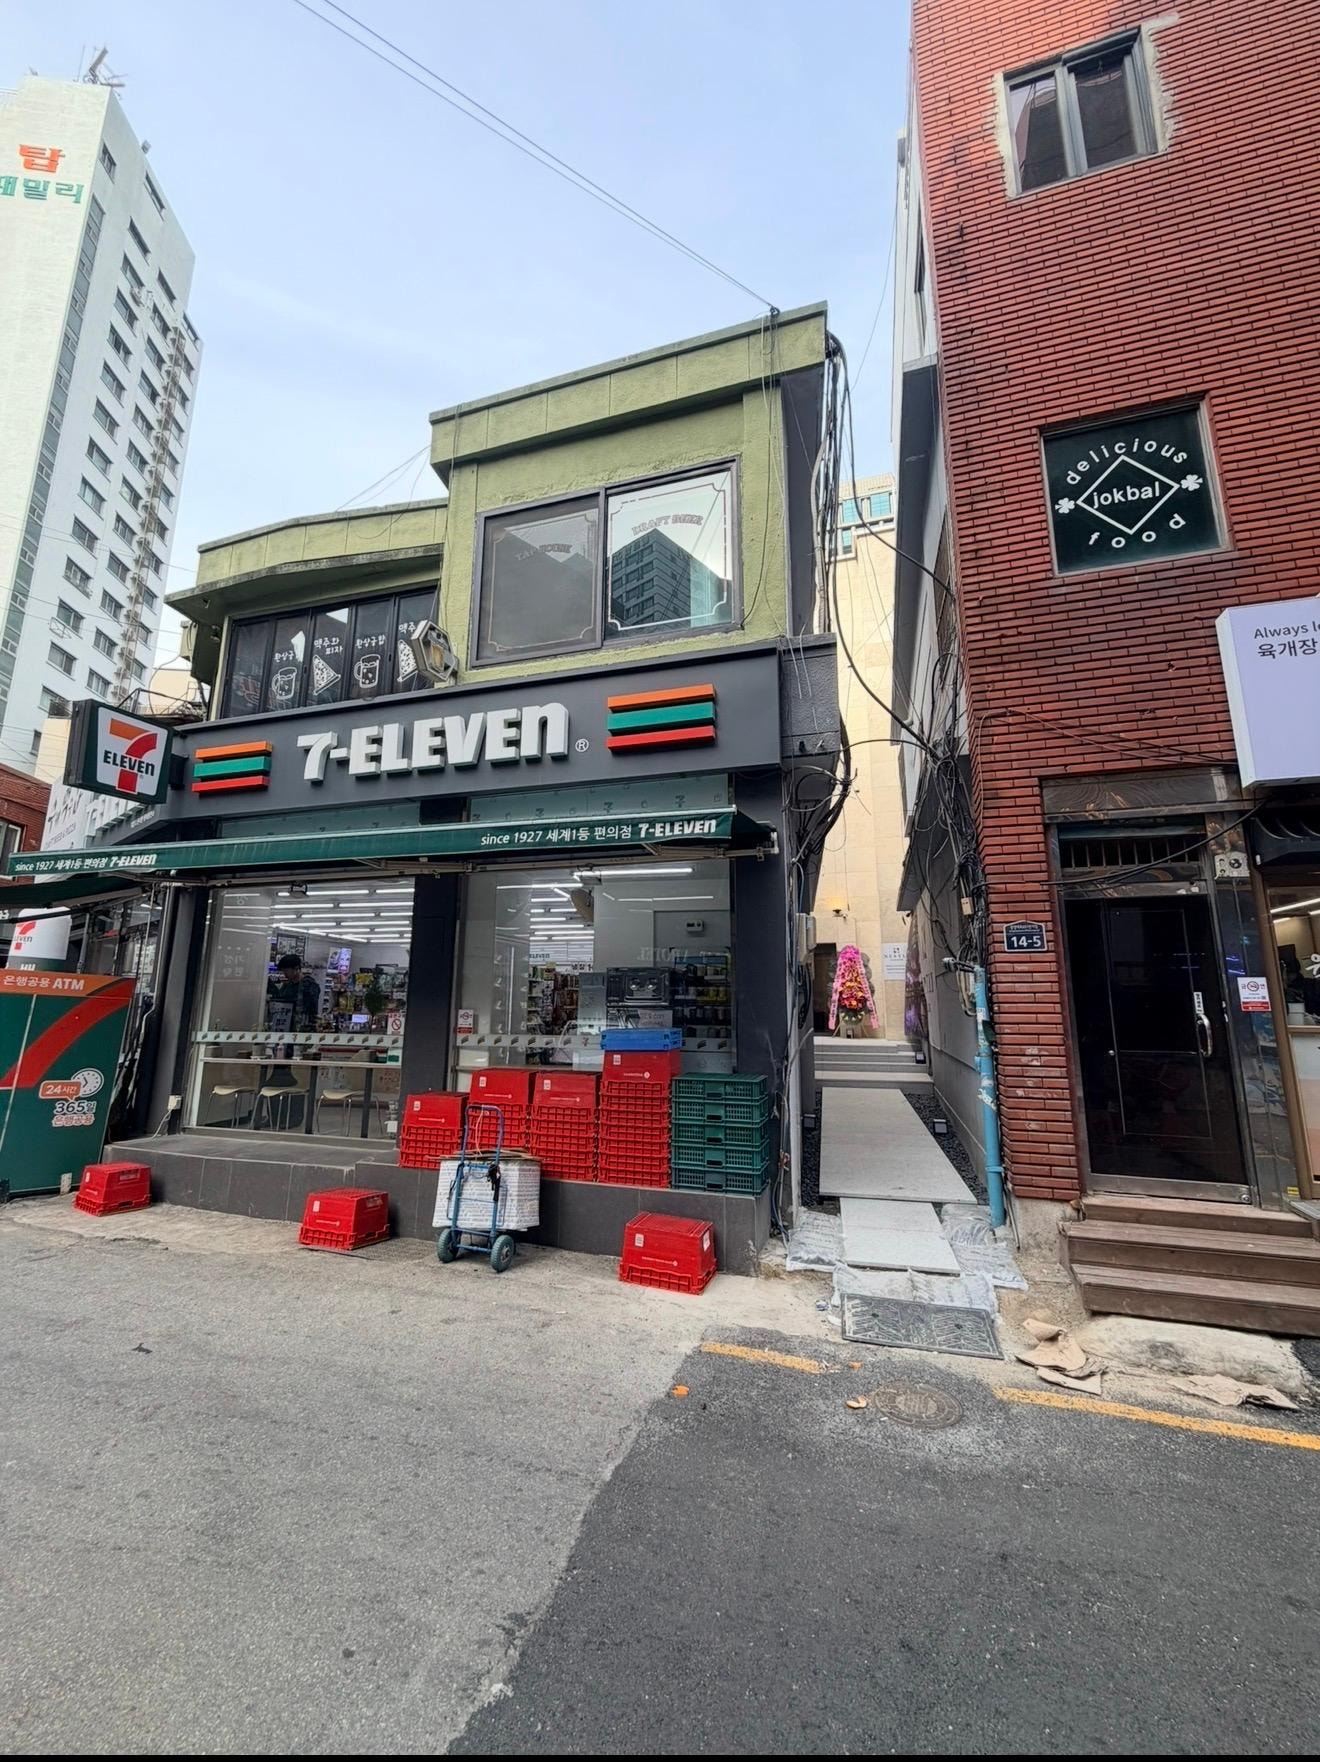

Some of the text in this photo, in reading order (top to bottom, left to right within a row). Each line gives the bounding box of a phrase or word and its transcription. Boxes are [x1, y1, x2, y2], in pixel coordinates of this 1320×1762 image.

[20, 144, 65, 173] 탑
[1066, 438, 1187, 485] delicious
[1092, 481, 1160, 509] jokbal
[1088, 513, 1187, 549] food
[398, 621, 416, 634] 맥주
[1254, 622, 1309, 640] Always
[274, 650, 295, 663] 환상궁
[325, 645, 344, 656] 피자
[1257, 637, 1319, 660] 육개장
[480, 833, 510, 846] since
[514, 830, 543, 843] 1927
[546, 827, 590, 843] 세계1등
[594, 824, 632, 840] 편의점
[15, 863, 34, 872] since
[36, 860, 54, 871] 1927
[1011, 935, 1041, 948] 14-5
[4, 975, 84, 991] 은행공용 ATM
[45, 1084, 77, 1095] 24시간
[56, 1101, 96, 1114] 365일
